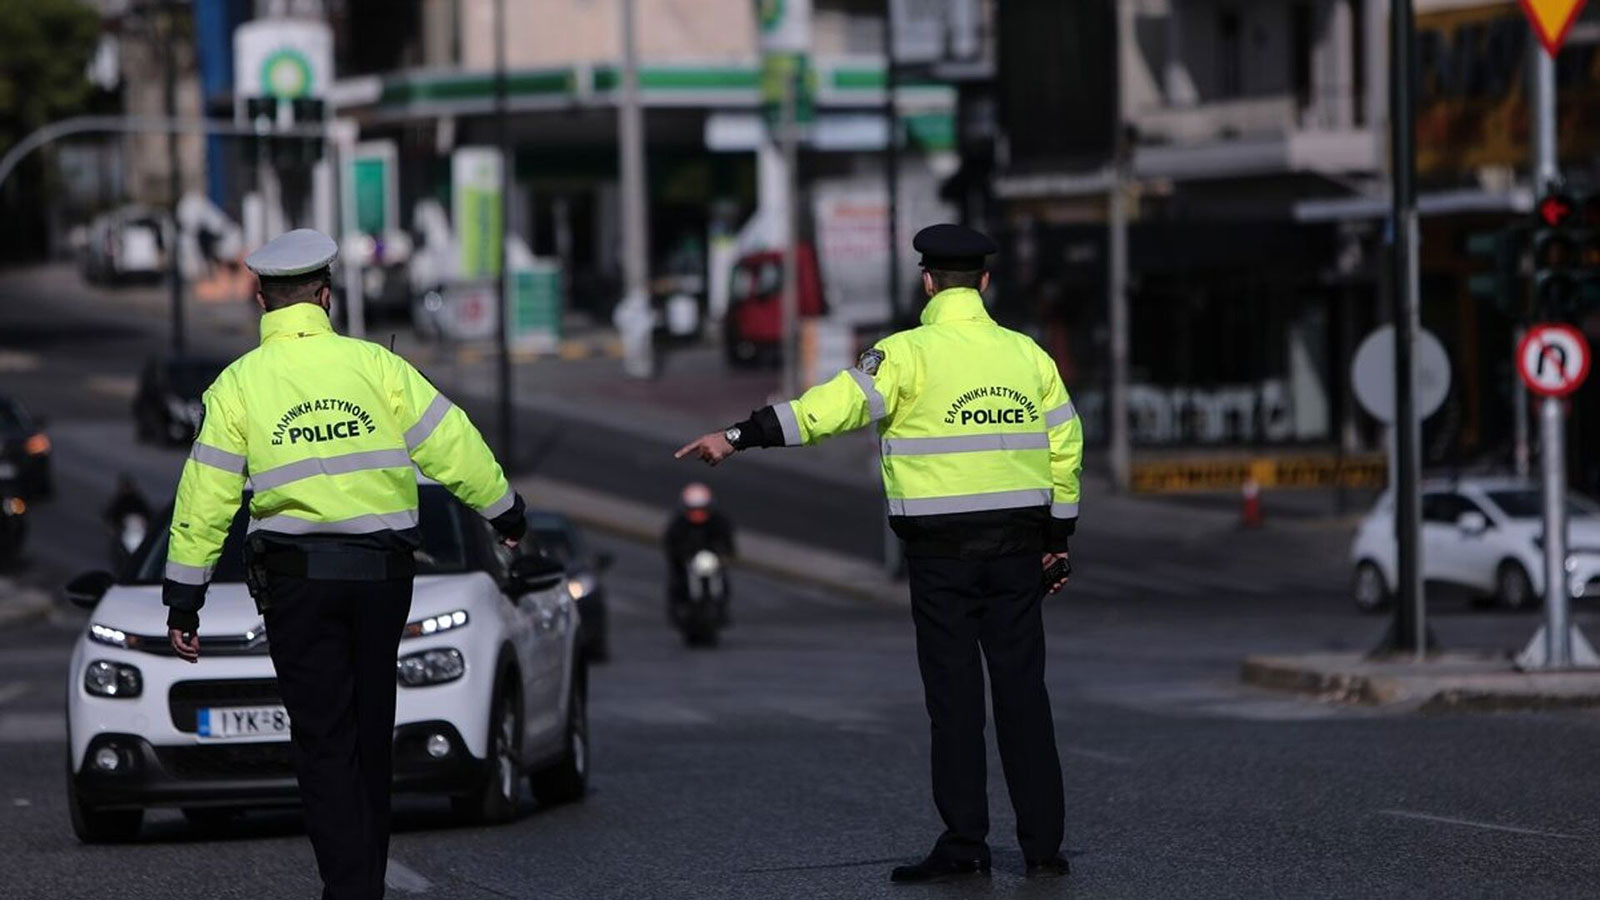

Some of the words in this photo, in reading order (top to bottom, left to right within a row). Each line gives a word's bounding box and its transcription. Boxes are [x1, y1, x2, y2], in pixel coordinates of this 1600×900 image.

[944, 387, 988, 424] ΕΛΛΗΝΙΚΗ
[990, 386, 1039, 422] ΑΣΤΥΝΟΜΙΑ
[961, 409, 1024, 425] POLICE
[272, 401, 312, 445] ΕΛΛΗΝΙΚΗ
[314, 399, 376, 434] ΑΣΤΥΝΟΜΙΑ
[288, 420, 360, 444] POLICE
